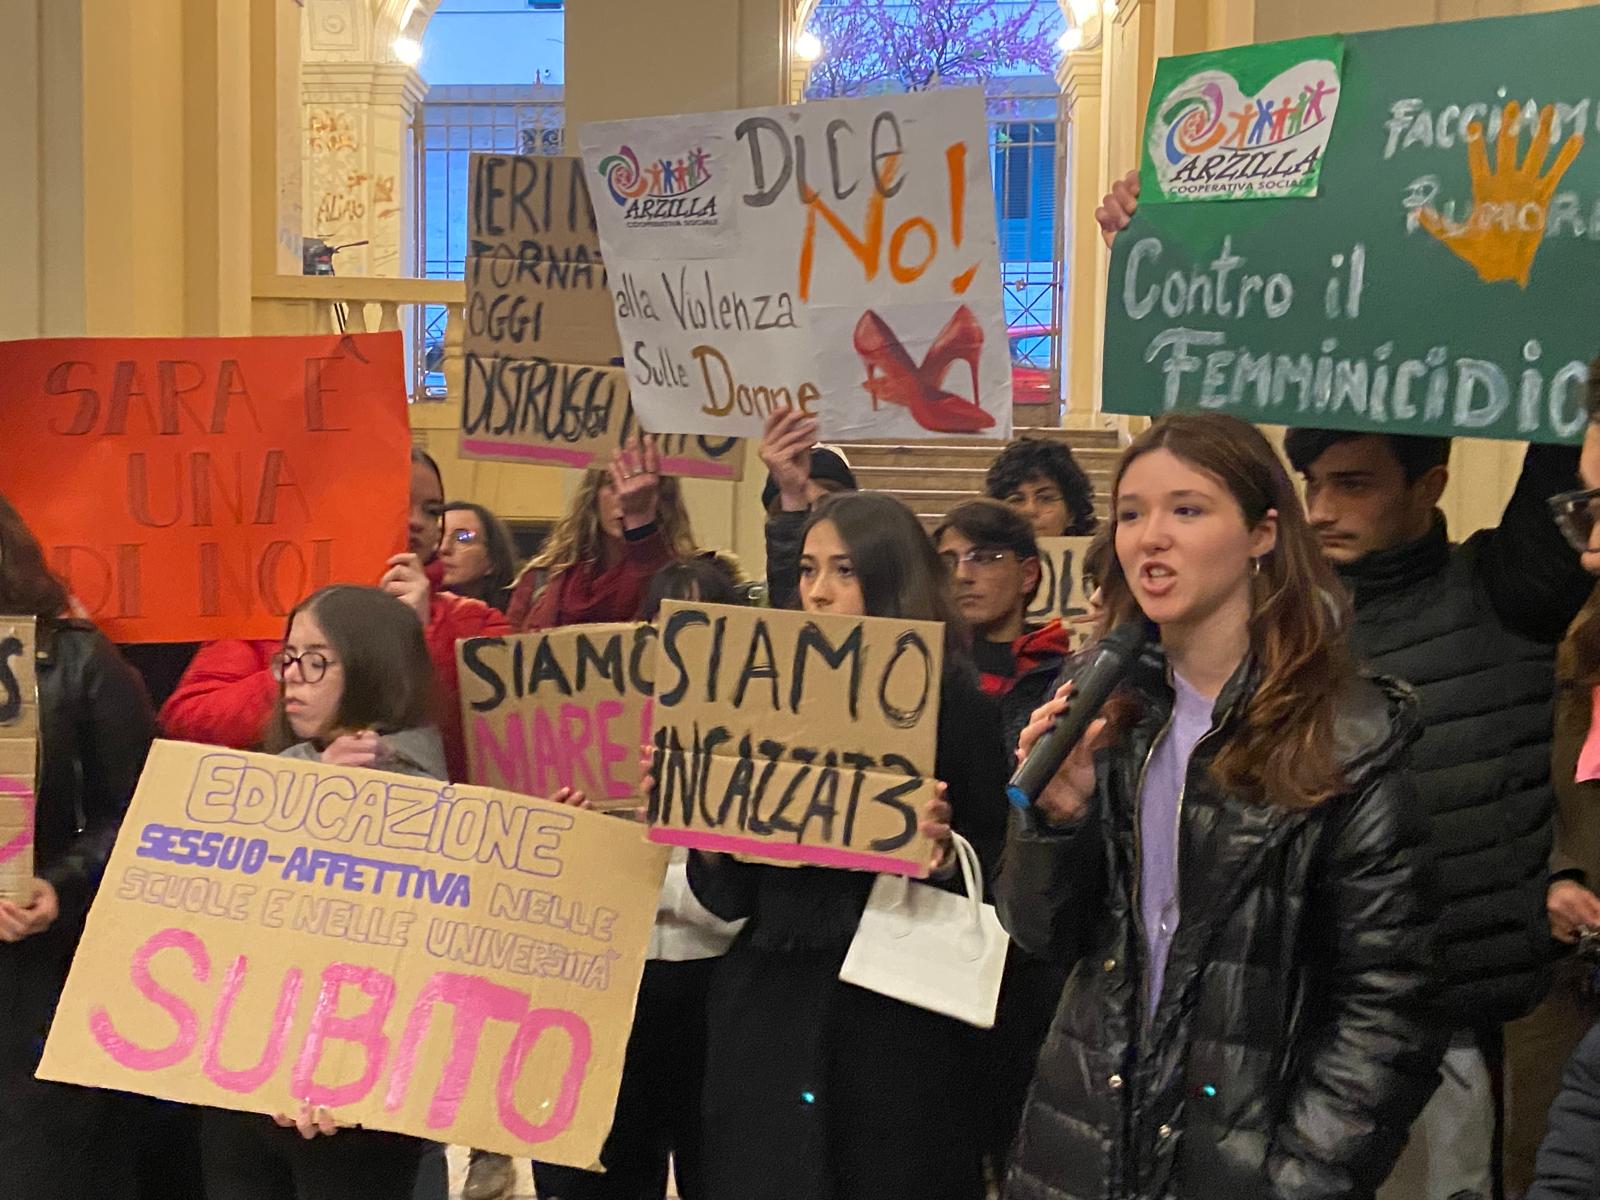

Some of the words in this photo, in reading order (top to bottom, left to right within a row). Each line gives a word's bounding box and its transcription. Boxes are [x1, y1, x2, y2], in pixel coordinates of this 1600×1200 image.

[474, 156, 553, 236] IERI
[1170, 145, 1321, 183] ARZILLA
[1170, 183, 1253, 195] COOPERATIVA
[624, 195, 718, 220] ARZILLA
[797, 141, 981, 303] No!
[469, 291, 543, 342] OGGI
[616, 272, 658, 321] alla
[662, 266, 799, 331] Violenza
[1122, 235, 1294, 320] Contro
[1325, 242, 1366, 319] il
[44, 360, 263, 436] SARA
[462, 352, 615, 443] DISTRUGGI
[634, 341, 690, 387] Sulle
[126, 450, 312, 528] UNA
[54, 543, 147, 620] DI
[199, 539, 334, 618] NOI
[659, 609, 934, 729] SIAMO
[118, 867, 256, 921] SCUOLE
[261, 887, 295, 928] E
[294, 894, 417, 947] NELLE
[136, 823, 470, 908] SESSUO-AFFETTIVA
[489, 882, 619, 942] NELLE
[89, 928, 591, 1144] SUBITO
